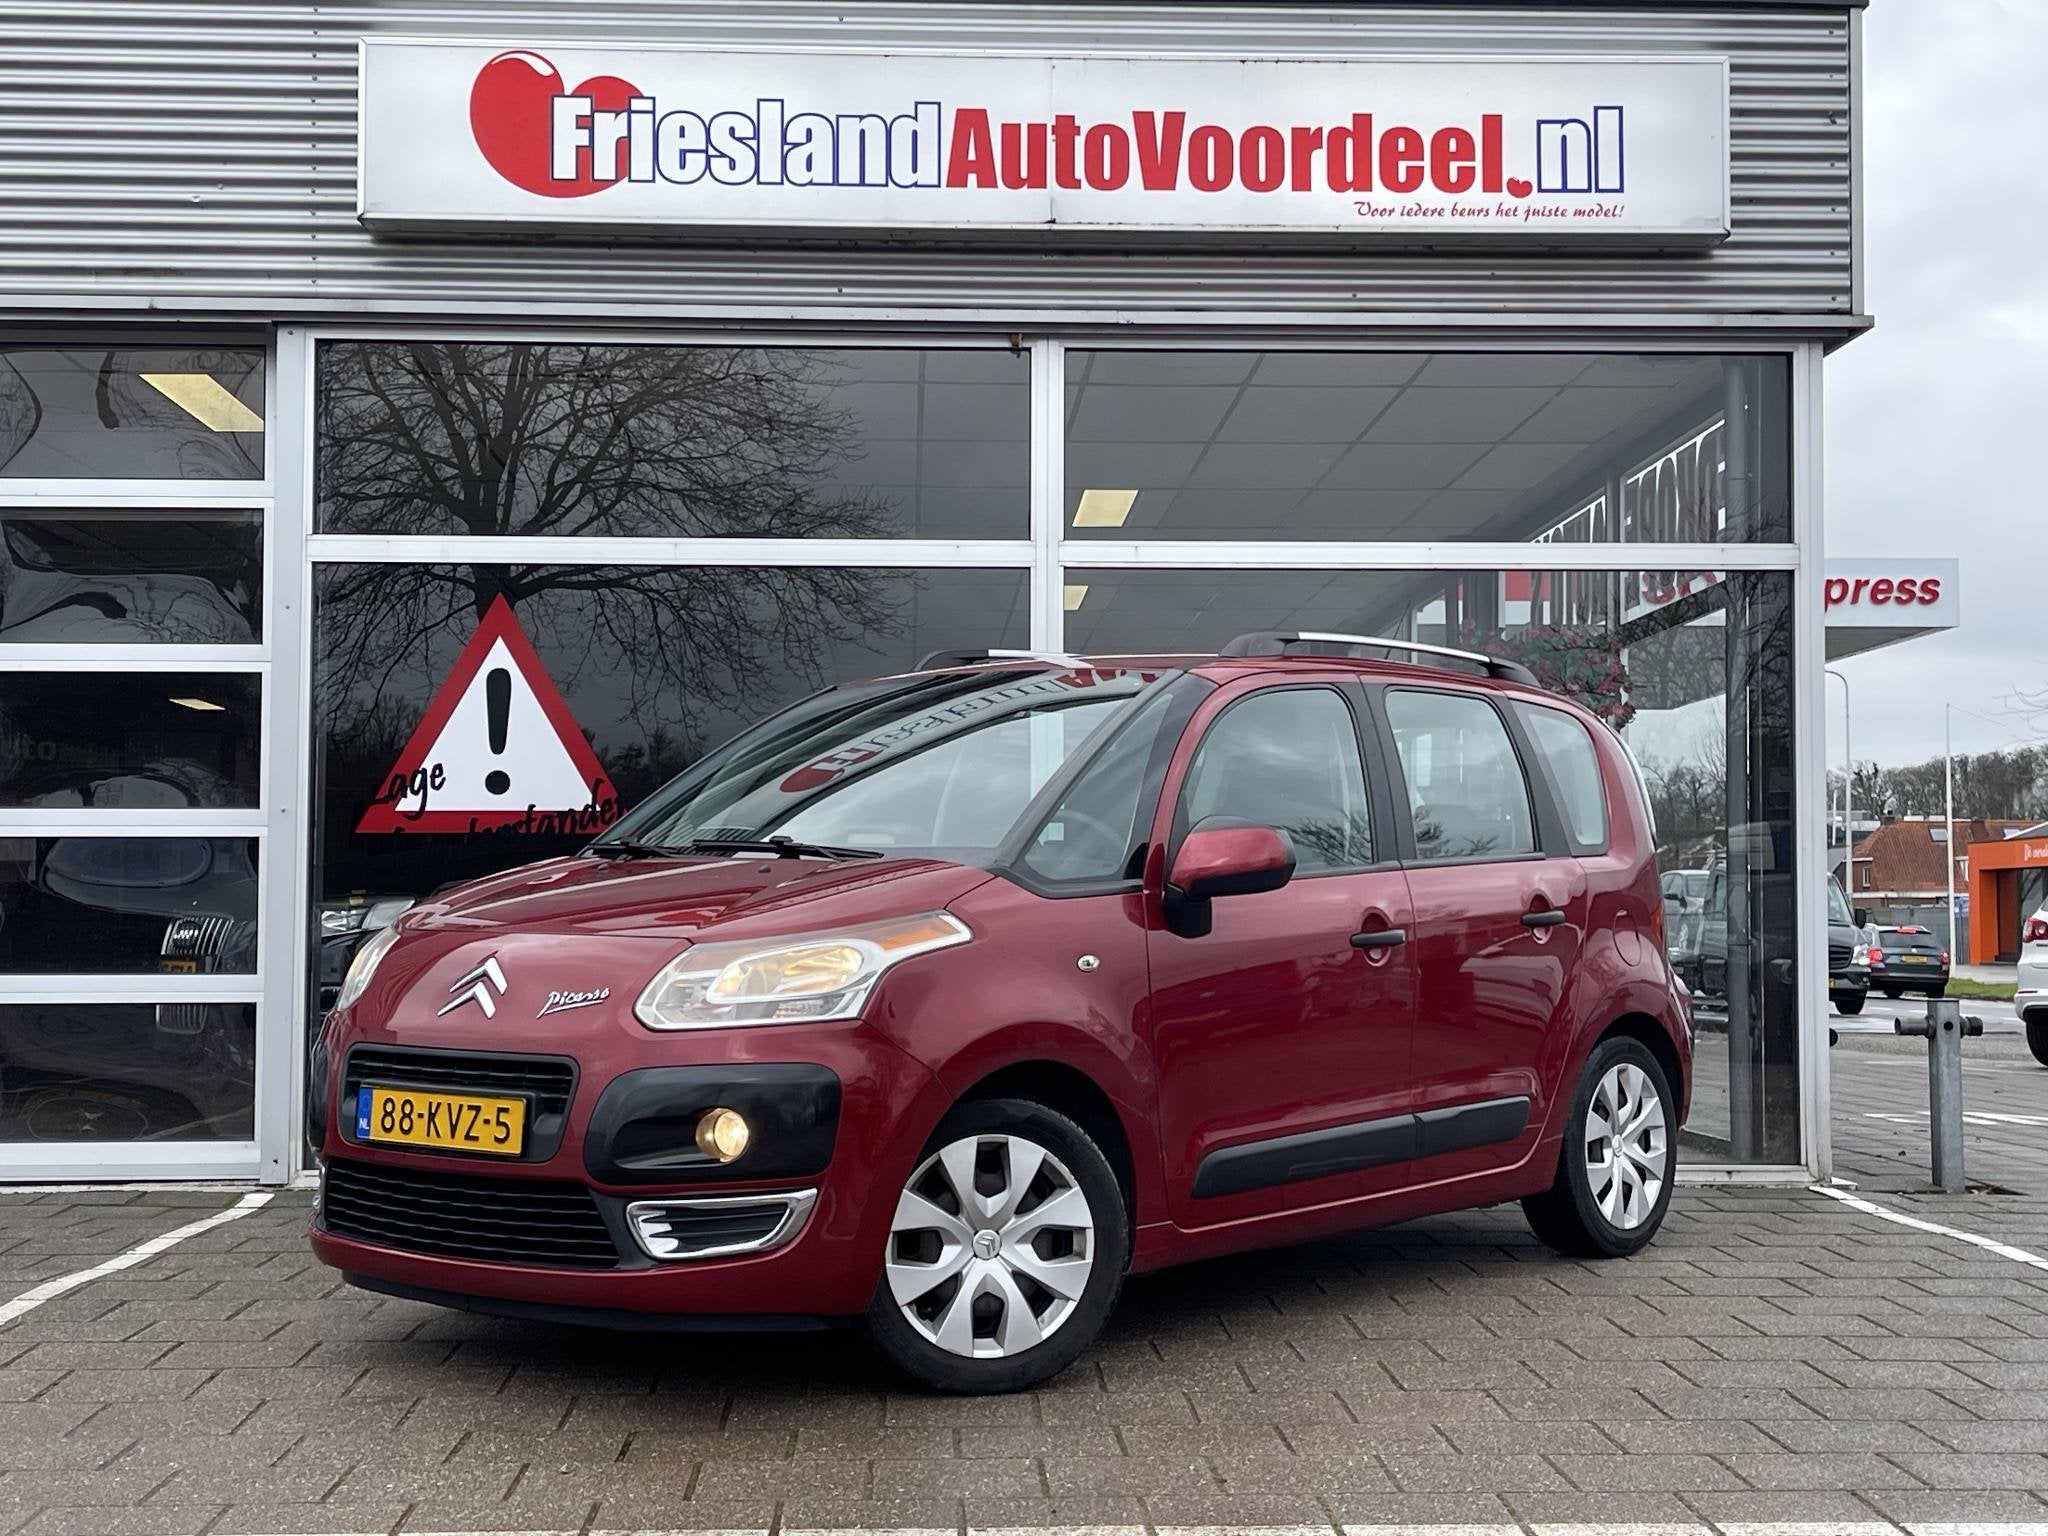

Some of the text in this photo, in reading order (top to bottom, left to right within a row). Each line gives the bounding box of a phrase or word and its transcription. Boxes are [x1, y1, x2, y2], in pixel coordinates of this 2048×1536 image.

[551, 94, 1625, 198] FrieslandAutoVoordeel.nl
[1353, 201, 1625, 223] Voor iedere beurs het juiste model!
[1824, 577, 1941, 613] press
[358, 1096, 511, 1145] NL 88-KVZ-5
